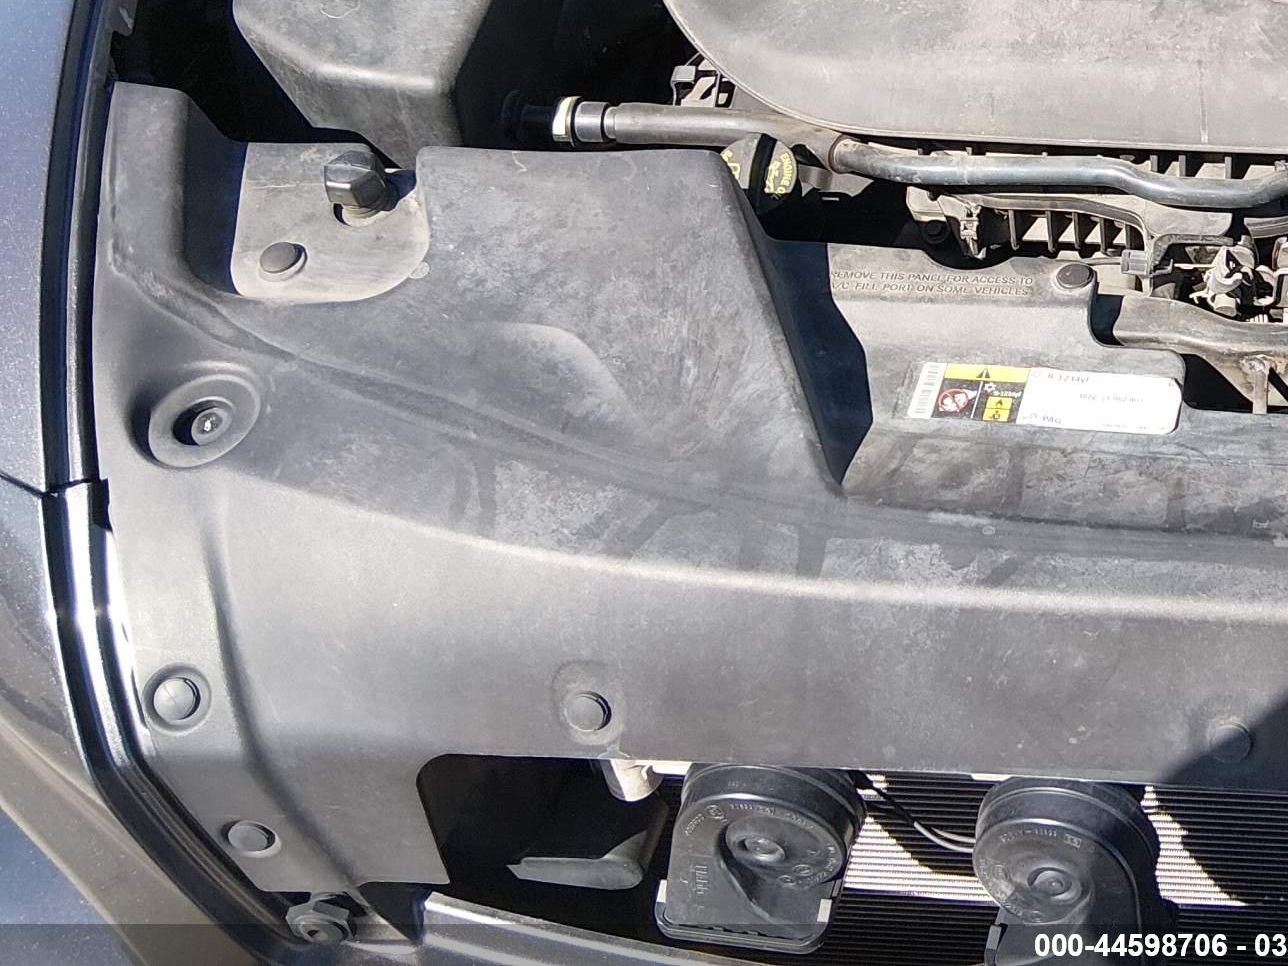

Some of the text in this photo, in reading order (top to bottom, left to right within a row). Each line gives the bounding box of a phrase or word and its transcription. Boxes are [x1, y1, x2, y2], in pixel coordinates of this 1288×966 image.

[776, 152, 793, 187] ENGINE
[880, 272, 904, 281] THIS
[907, 273, 944, 282] PANEL
[944, 274, 969, 283] FOR
[972, 275, 1016, 284] ACCESS
[1019, 276, 1034, 285] TO
[855, 282, 878, 291] FILL
[883, 283, 912, 292] PORT
[916, 284, 934, 292] ON
[936, 284, 970, 294] SOME
[974, 286, 1030, 295] VEHICLES
